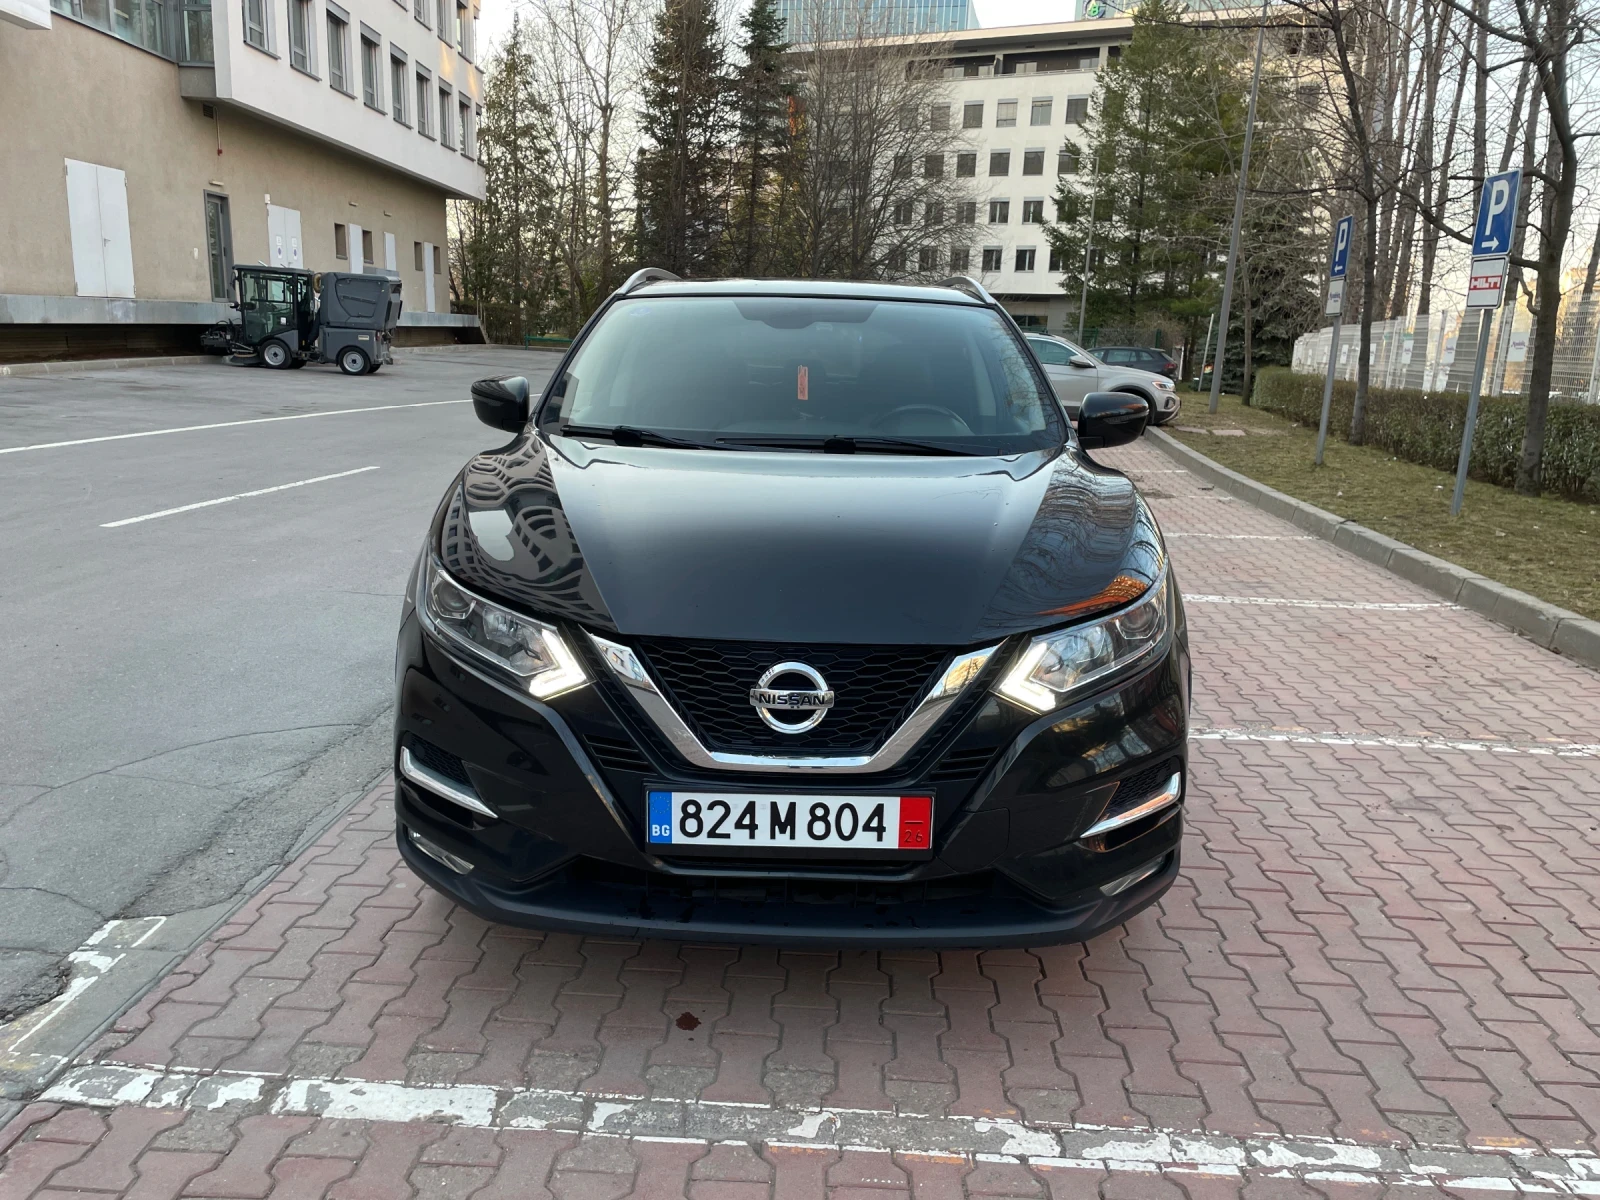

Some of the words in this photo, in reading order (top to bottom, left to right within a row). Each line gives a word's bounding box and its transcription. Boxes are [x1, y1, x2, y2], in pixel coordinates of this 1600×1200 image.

[1485, 179, 1509, 236] P
[1335, 221, 1348, 262] P
[1470, 277, 1501, 288] HILTI
[758, 692, 825, 706] NISSAN
[652, 824, 670, 837] BG
[904, 829, 923, 843] 26
